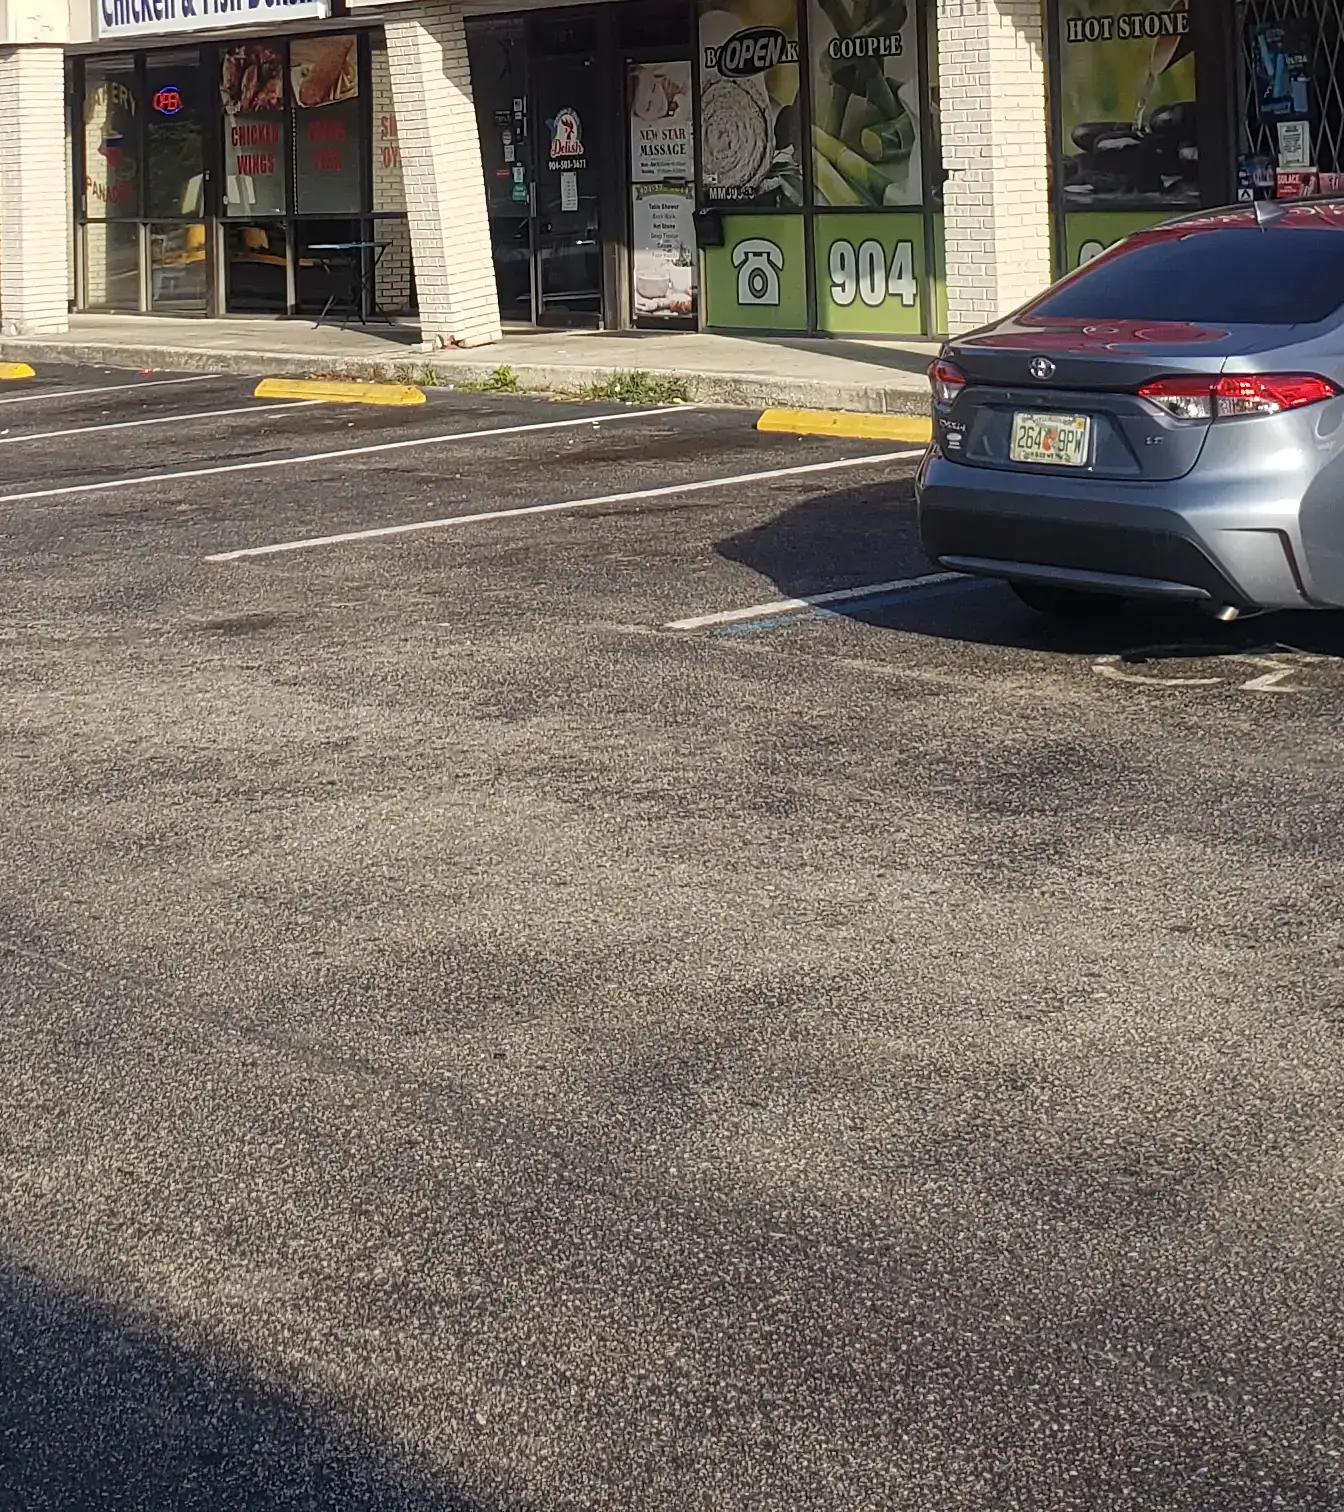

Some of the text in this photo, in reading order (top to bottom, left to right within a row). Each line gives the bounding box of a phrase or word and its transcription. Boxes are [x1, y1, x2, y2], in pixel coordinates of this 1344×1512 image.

[1068, 12, 1189, 41] HOT STONE
[725, 36, 783, 69] OPEN
[828, 33, 902, 59] COUPLE
[640, 127, 686, 141] NEW STAR
[551, 139, 584, 157] Delish
[640, 144, 686, 156] MASSAGE
[237, 153, 275, 175] WINGS
[828, 238, 918, 308] 904
[1017, 425, 1043, 450] 264
